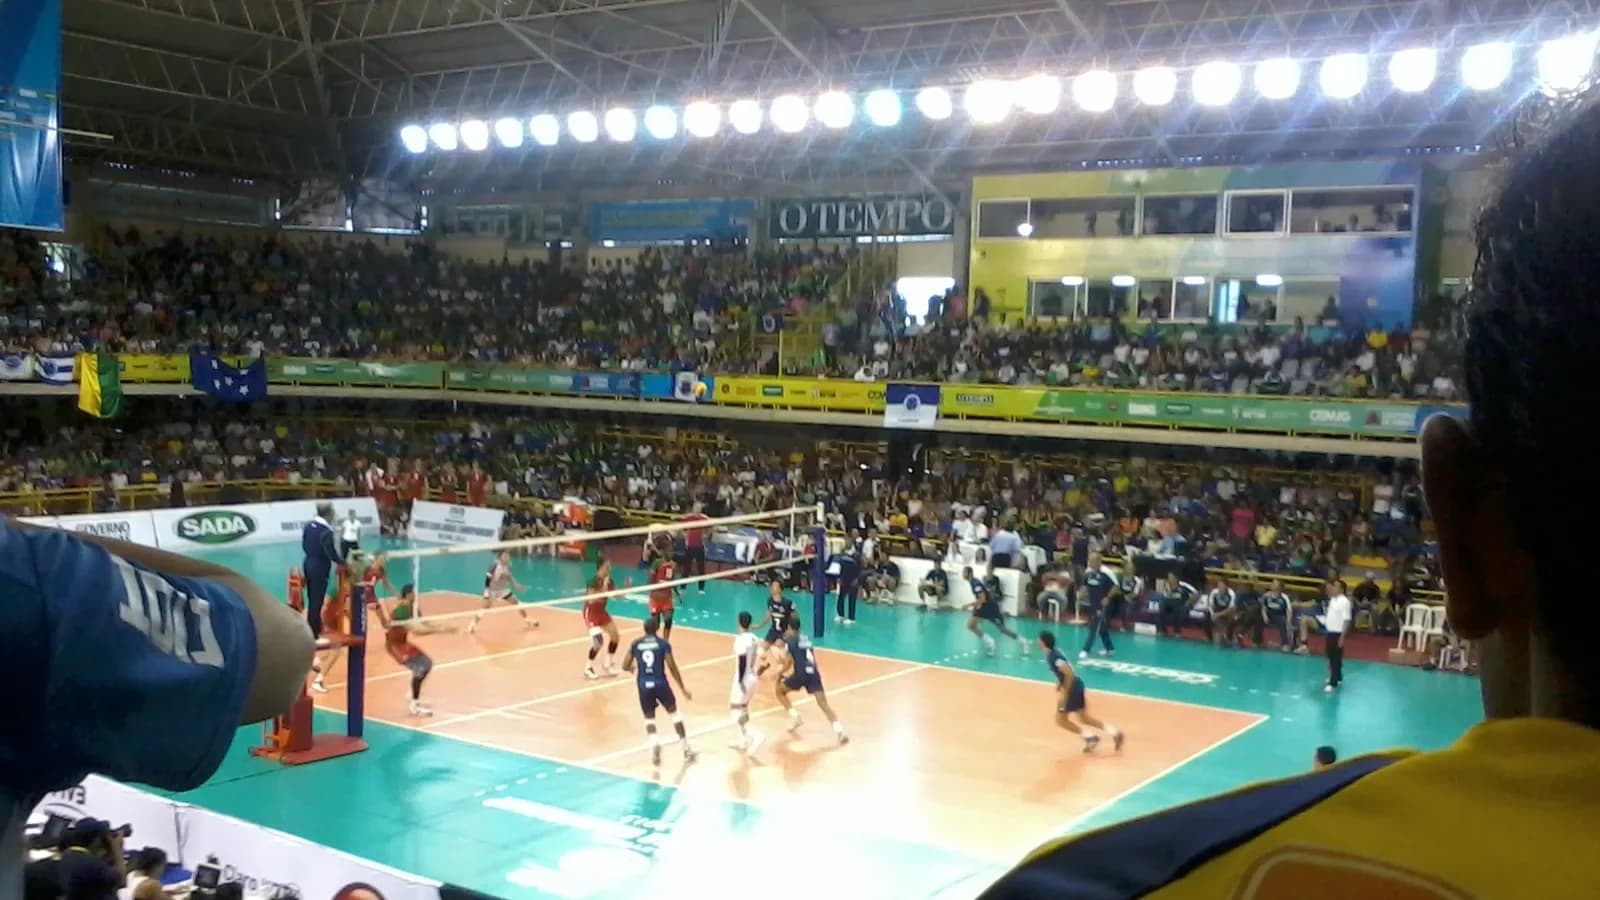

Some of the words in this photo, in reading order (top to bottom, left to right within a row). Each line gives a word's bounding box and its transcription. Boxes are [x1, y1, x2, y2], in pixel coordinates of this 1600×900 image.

[779, 203, 807, 234] O
[811, 197, 953, 233] TEMPO
[182, 516, 249, 537] SADA
[642, 650, 655, 667] 9
